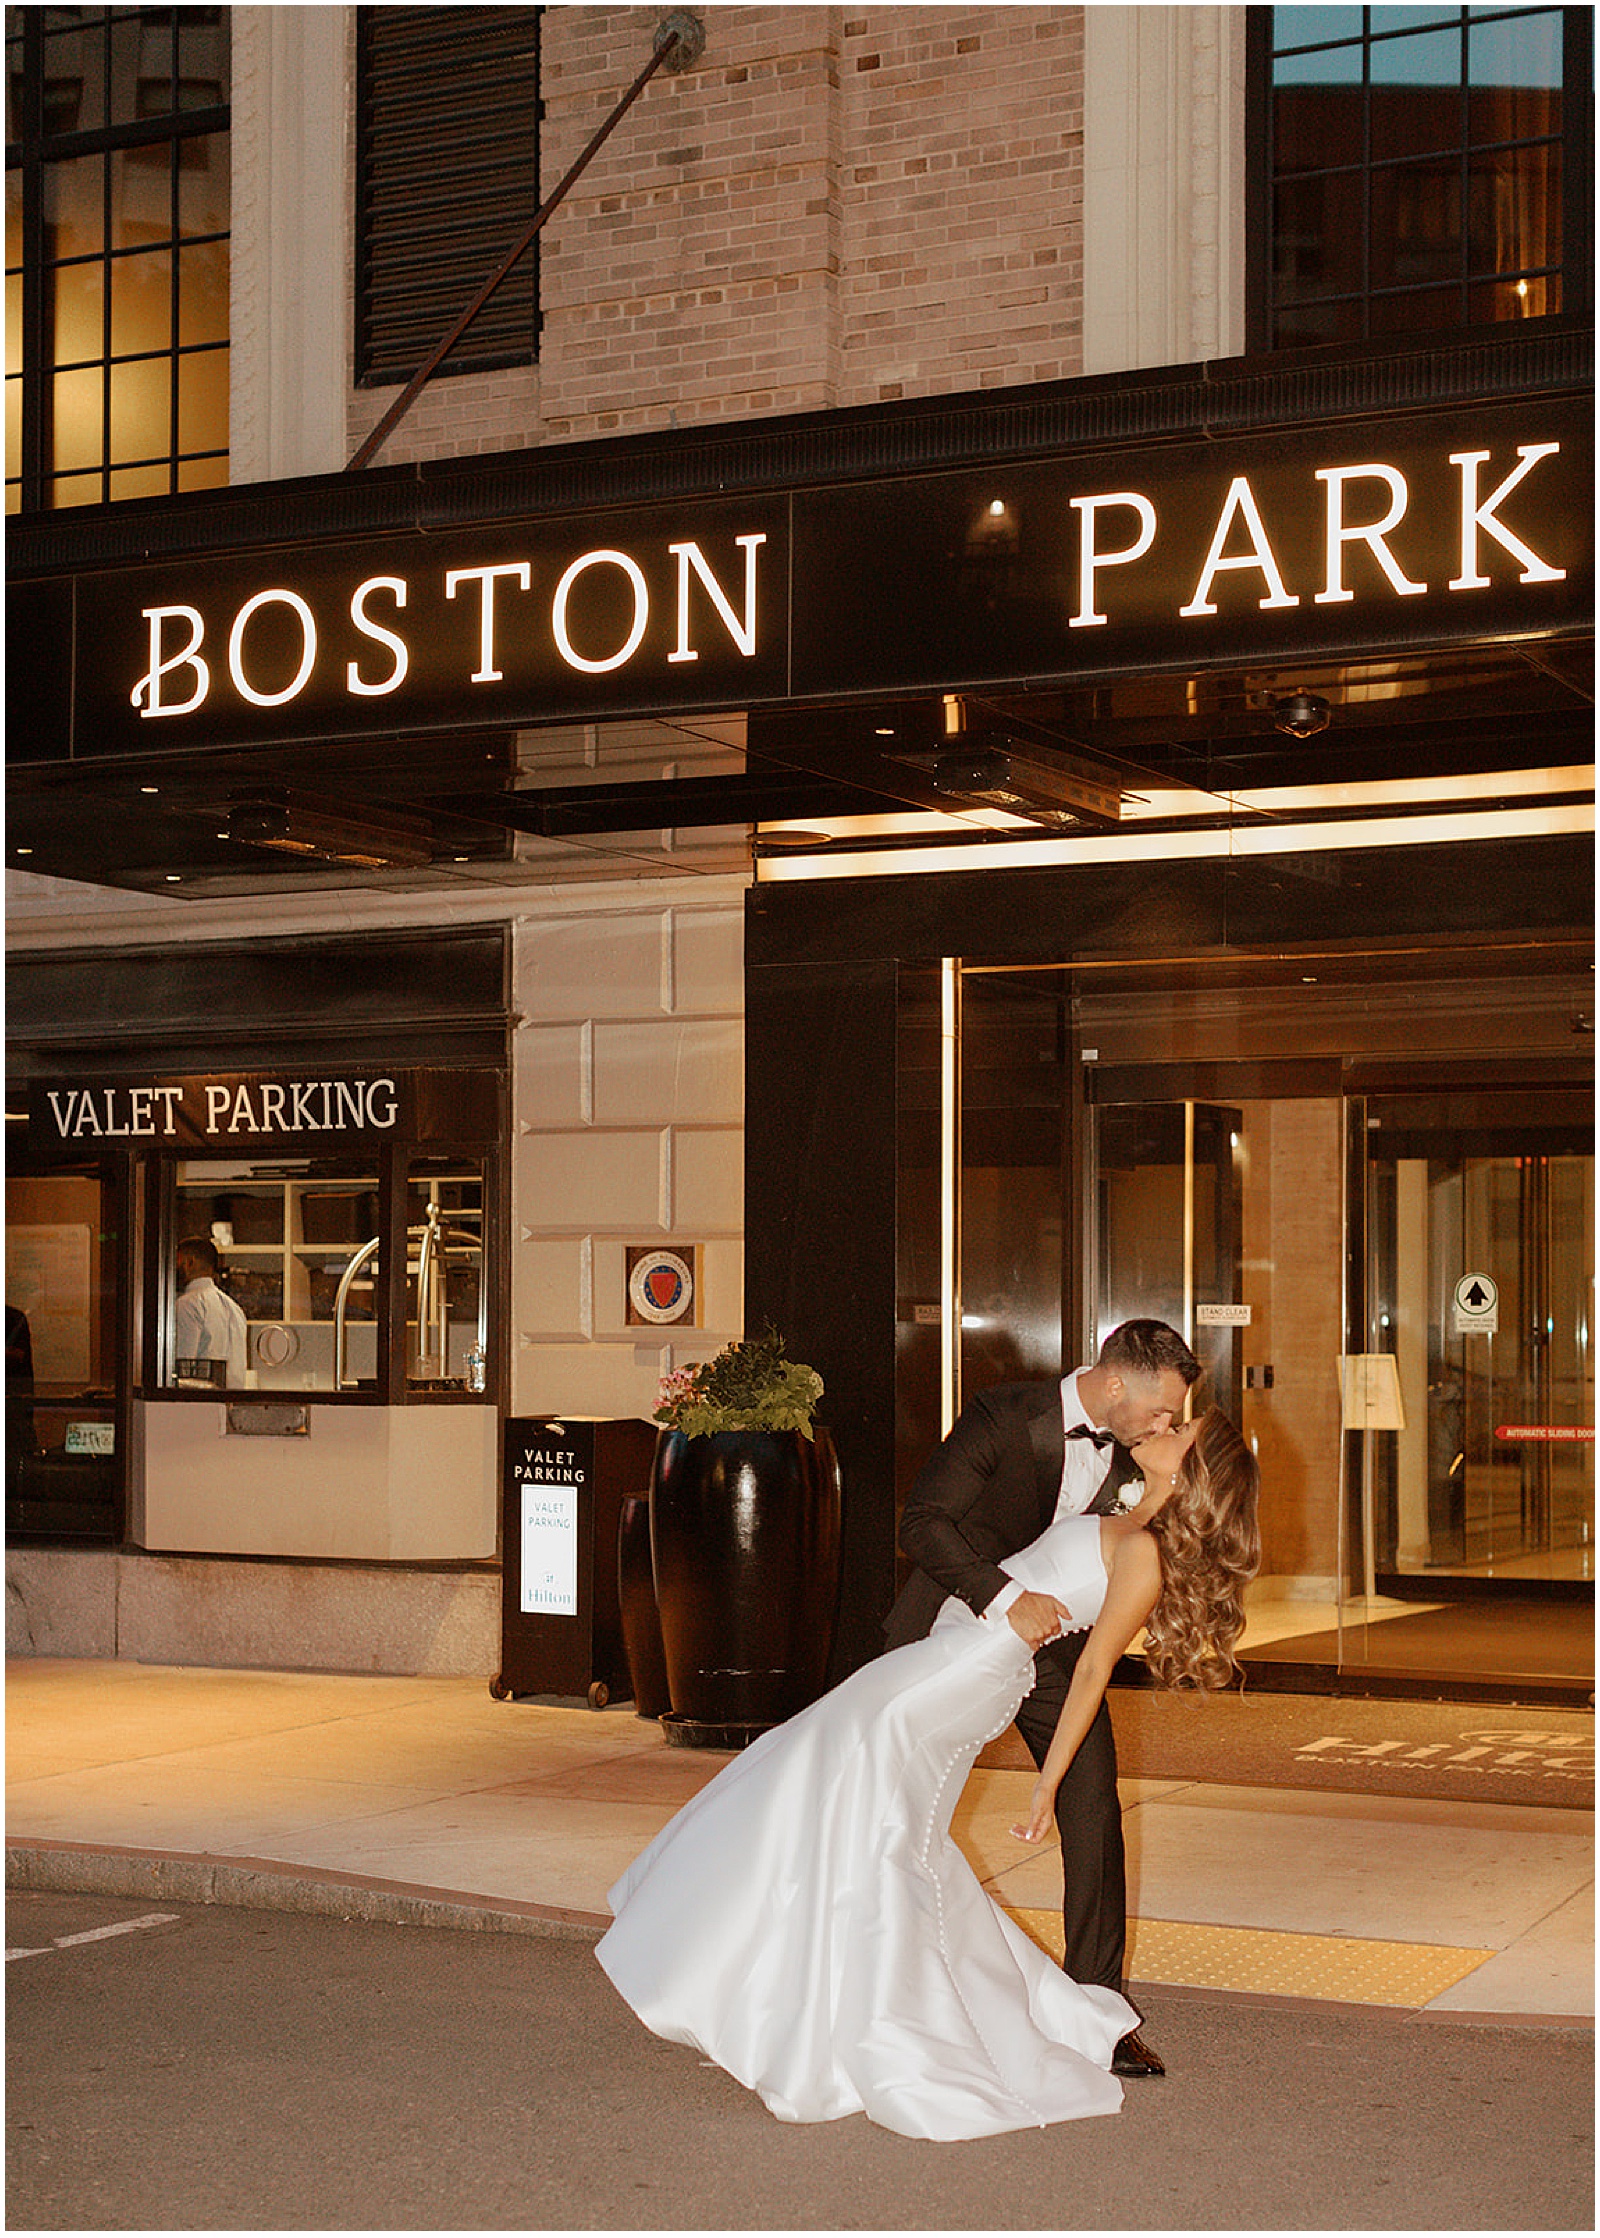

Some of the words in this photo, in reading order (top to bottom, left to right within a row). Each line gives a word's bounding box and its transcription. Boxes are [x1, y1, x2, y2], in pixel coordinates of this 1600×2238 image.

[131, 534, 767, 718] BOSTON
[1069, 442, 1567, 628] PARK
[47, 1087, 183, 1137] VALET
[205, 1079, 398, 1134] PARKING
[1507, 1429, 1546, 1438] AUTOMATIC
[1548, 1430, 1575, 1438] SLIDING
[524, 1449, 574, 1465] VALET
[514, 1465, 584, 1483] PARKING
[534, 1502, 564, 1513] VALET
[528, 1516, 571, 1529] PARKING
[528, 1588, 571, 1604] Hilton
[1294, 1754, 1436, 1769] BOSTON
[1442, 1764, 1532, 1775] PARK
